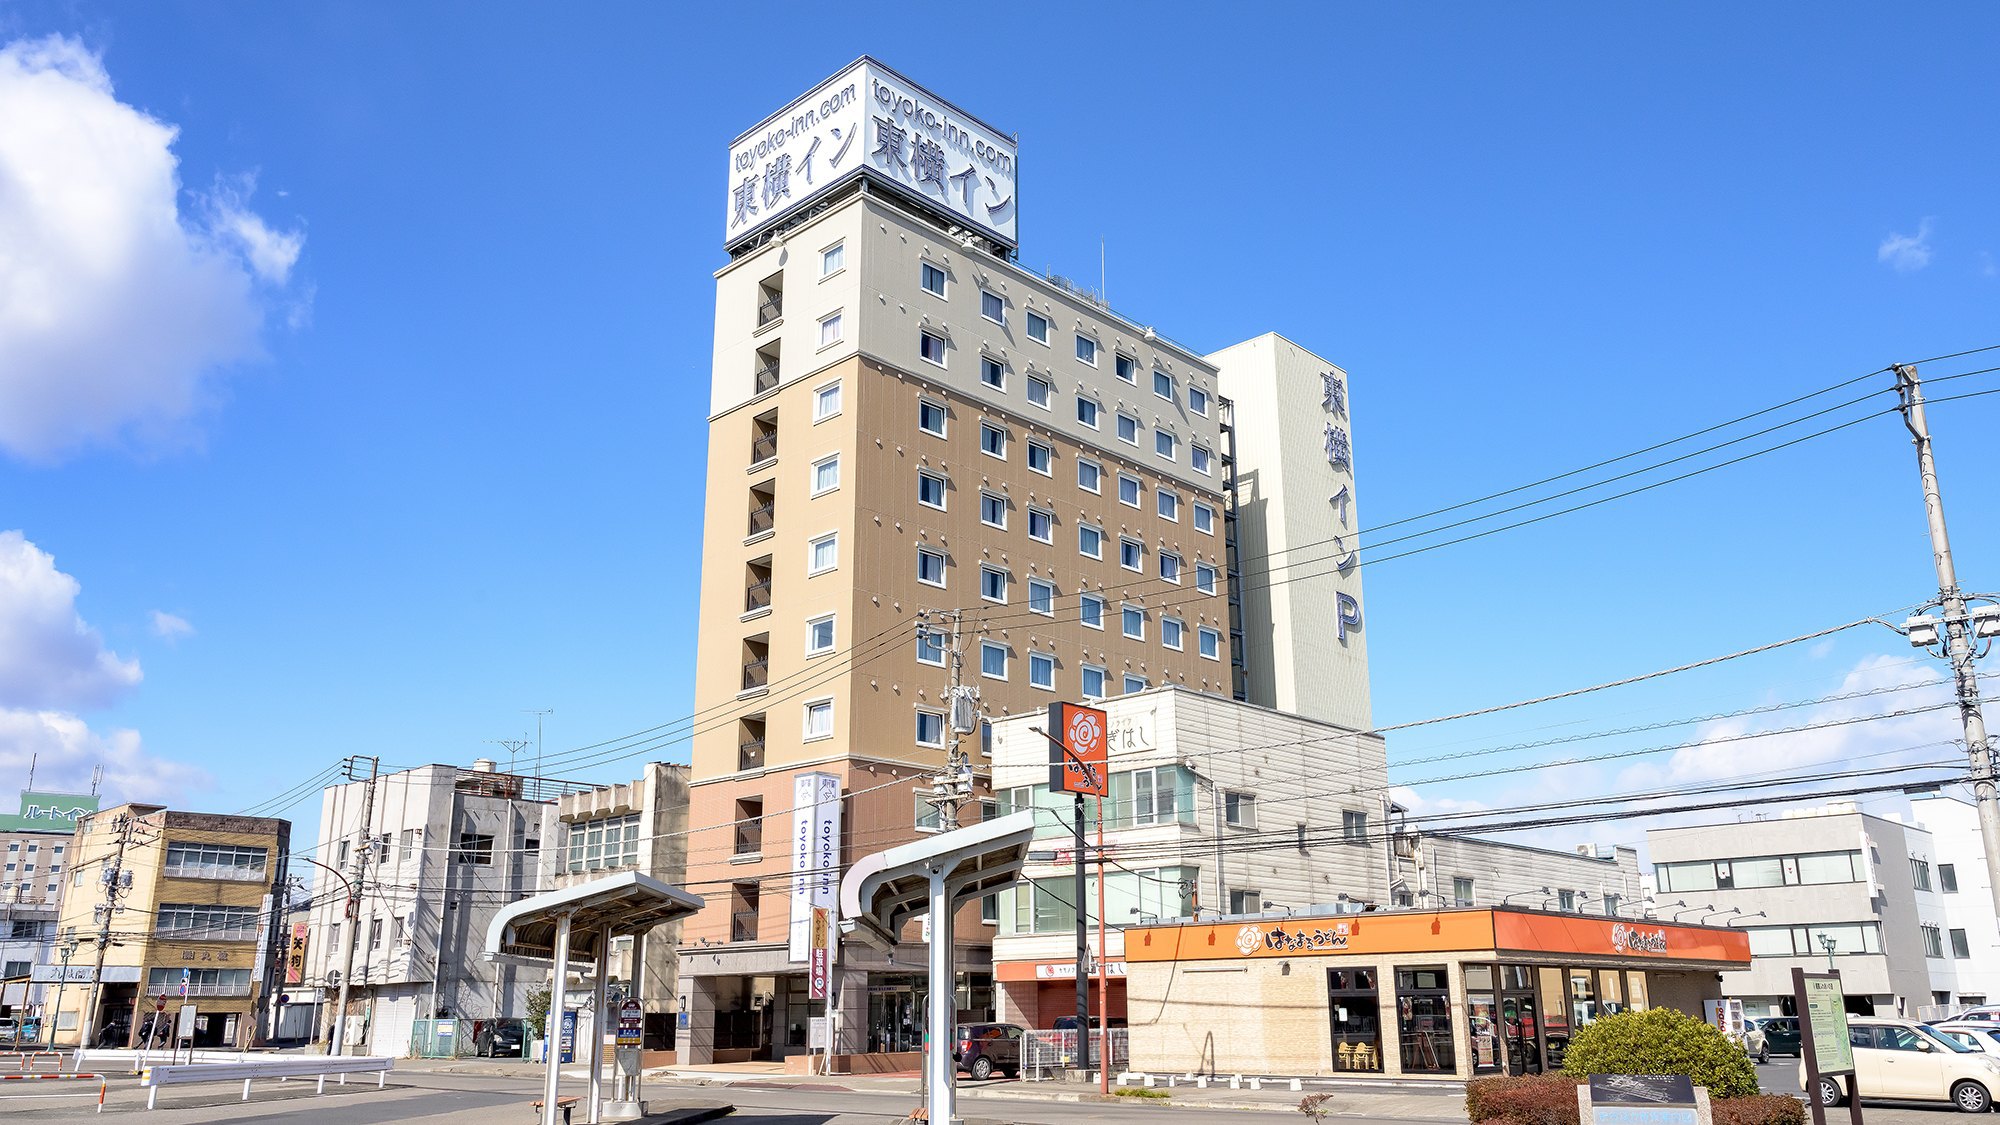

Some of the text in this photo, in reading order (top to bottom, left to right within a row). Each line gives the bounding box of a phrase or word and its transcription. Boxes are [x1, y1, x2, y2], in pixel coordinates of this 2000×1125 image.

[735, 82, 857, 174] toyoko-inn.com
[871, 77, 1012, 174] toyoko-inn.com
[871, 114, 1012, 216] 東横イン
[730, 122, 858, 230] 東横イン
[799, 820, 808, 868] toyoko
[822, 819, 832, 895] toyoko inn
[1265, 926, 1347, 952] はなまるうどん
